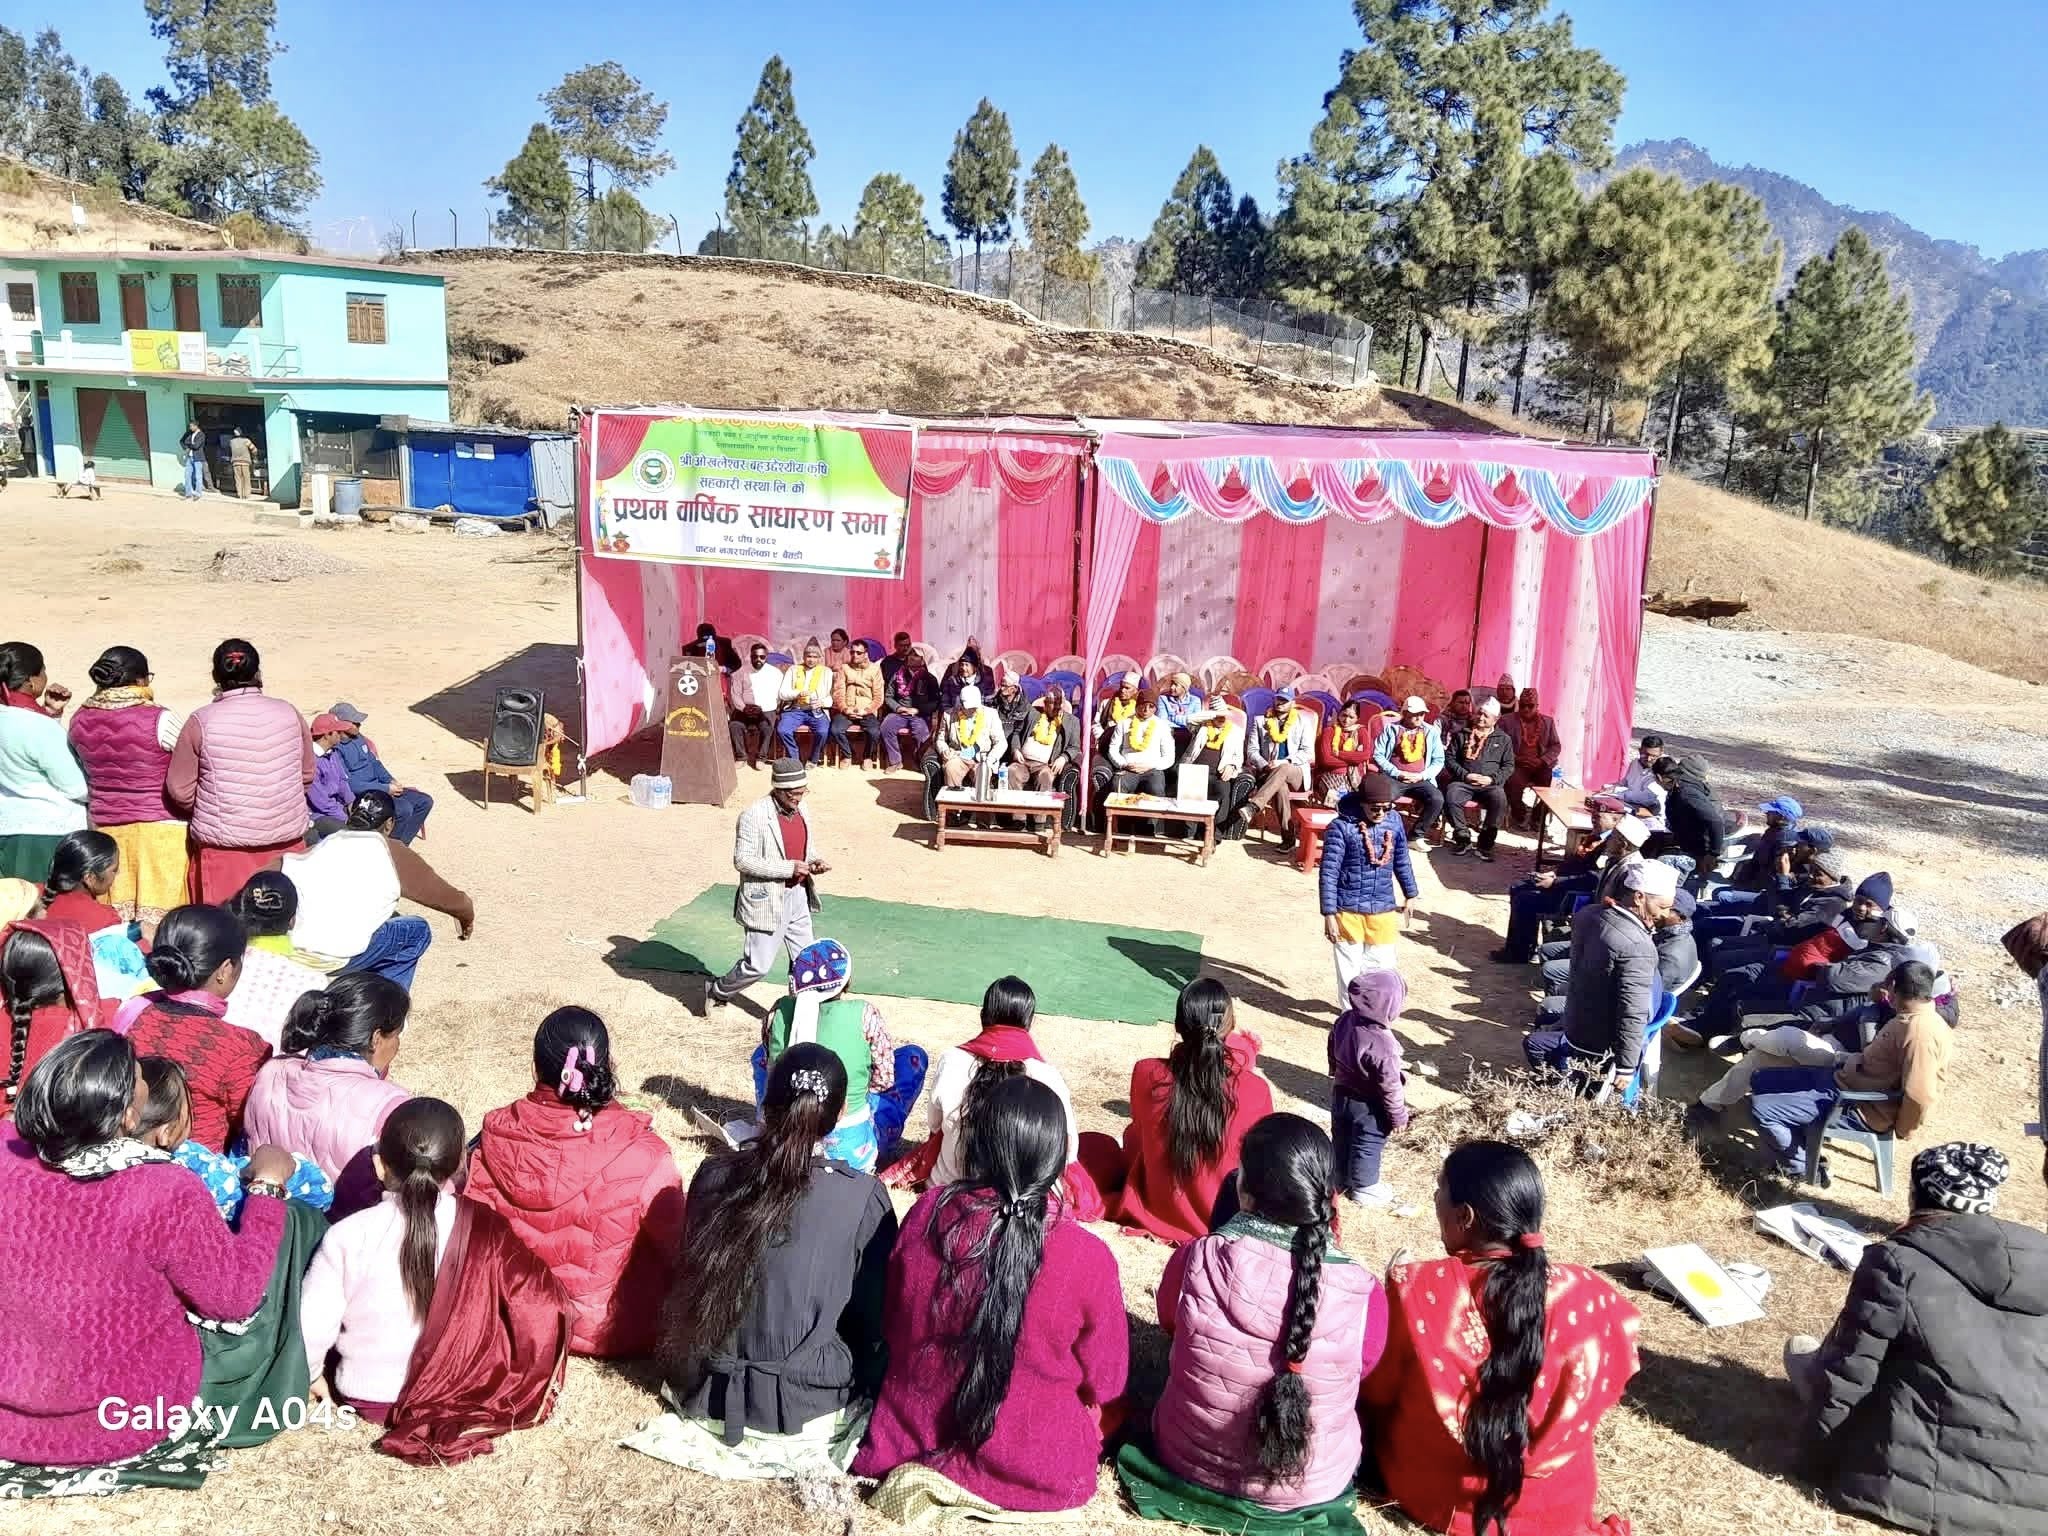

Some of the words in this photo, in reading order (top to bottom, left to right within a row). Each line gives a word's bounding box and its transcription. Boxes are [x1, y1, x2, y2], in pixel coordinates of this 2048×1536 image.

[699, 476, 740, 490] सहकारी
[613, 498, 669, 523] प्रथम
[676, 493, 741, 525] वार्षिक
[747, 505, 834, 533] साधारण
[841, 511, 888, 536] सभा
[719, 547, 770, 558] नगरपालिका
